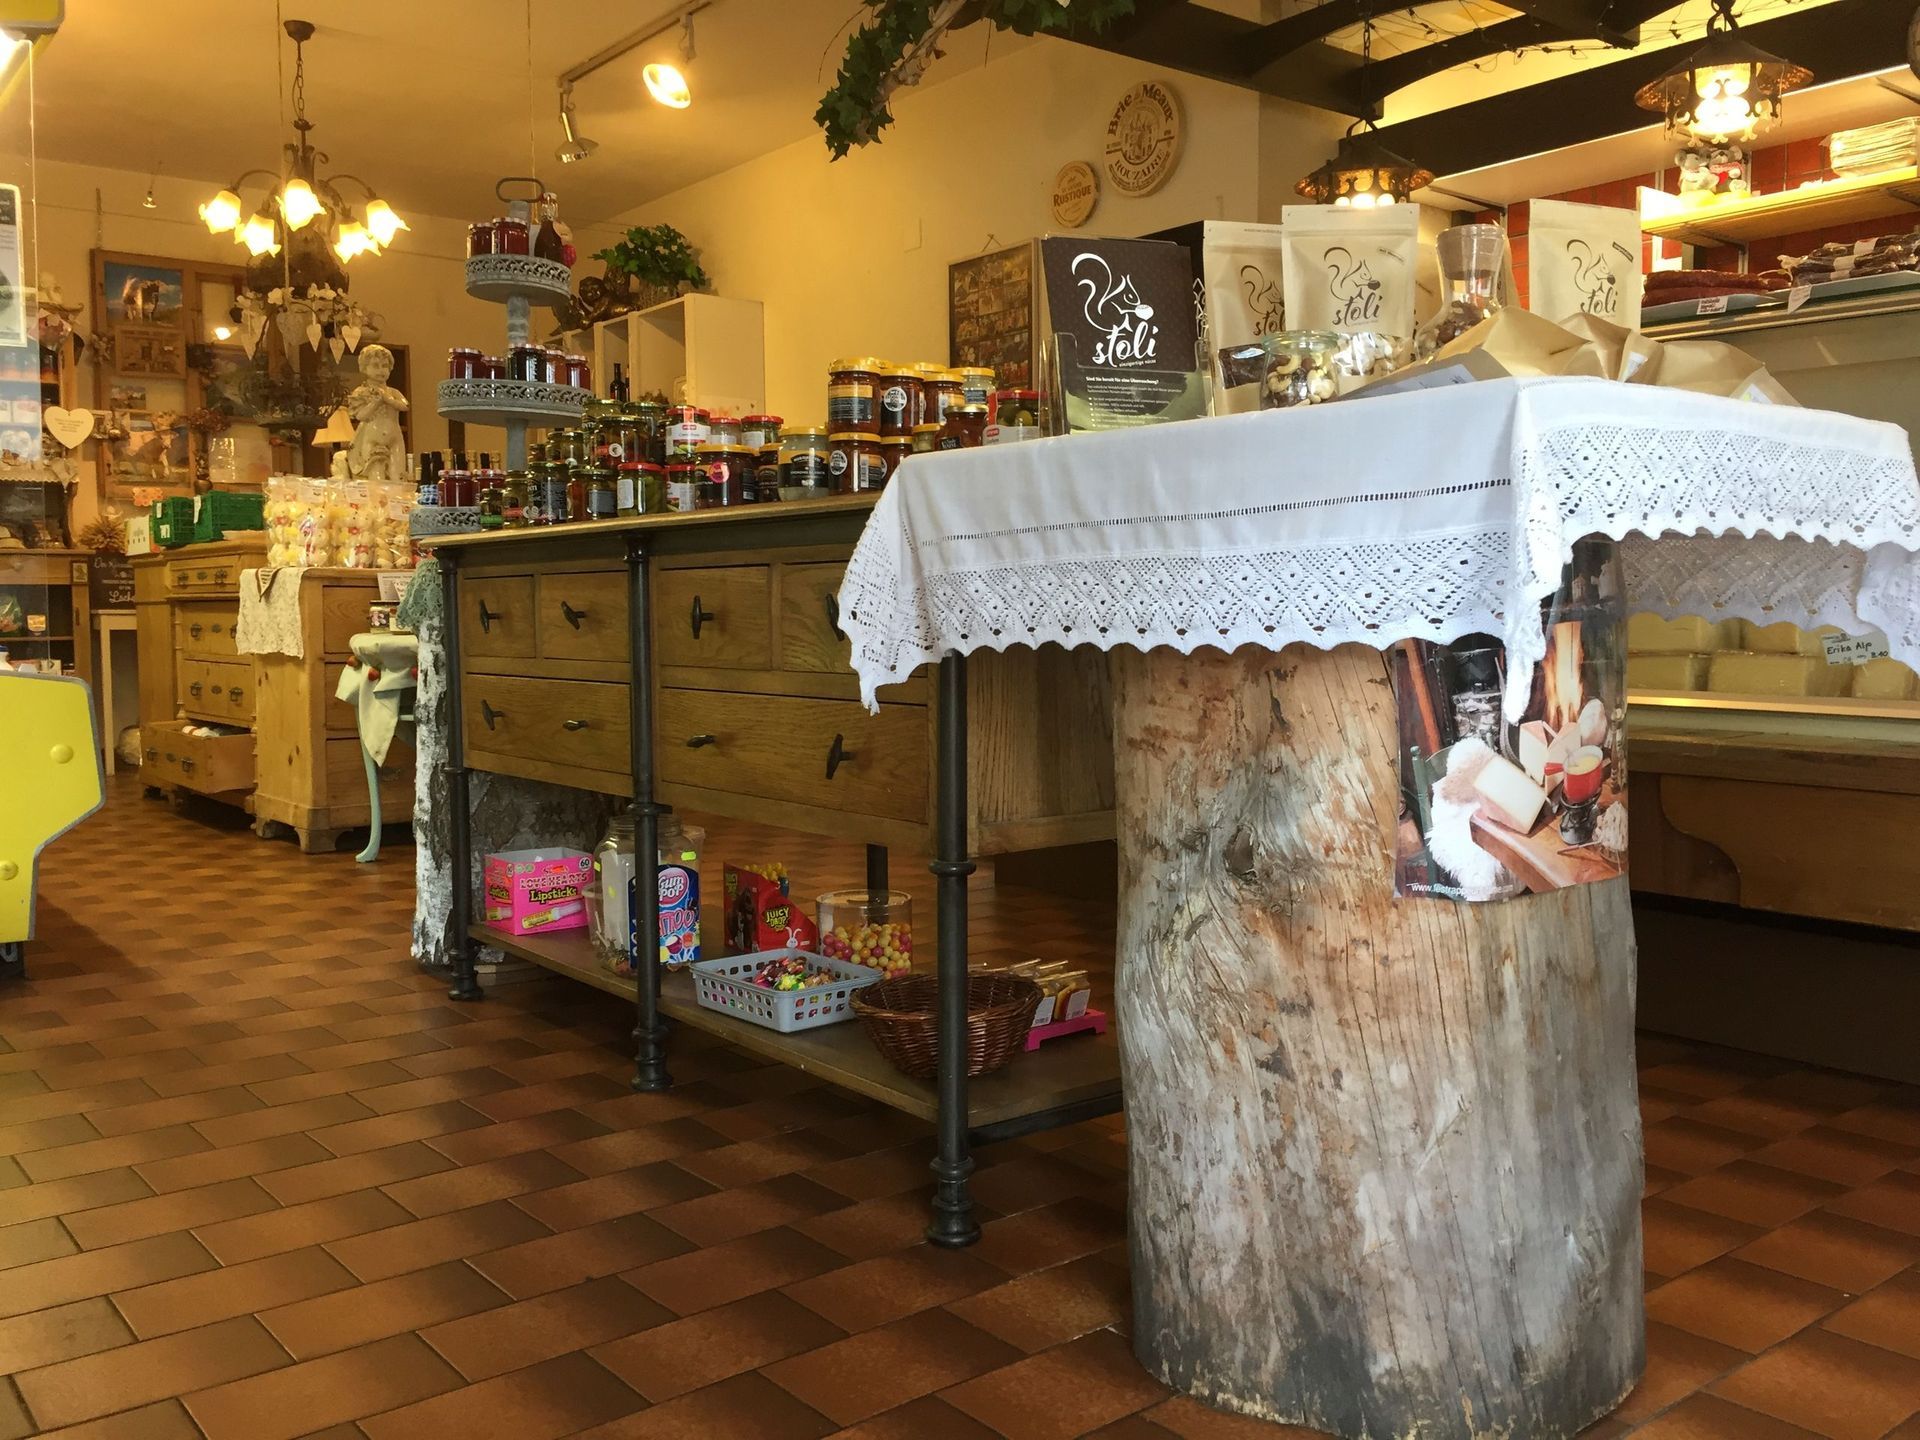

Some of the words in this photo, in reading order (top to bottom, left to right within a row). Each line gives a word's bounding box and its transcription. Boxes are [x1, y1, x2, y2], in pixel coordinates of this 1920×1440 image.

[1108, 94, 1133, 136] Brie
[1142, 84, 1174, 123] Meaux
[1332, 292, 1383, 327] stoli
[1092, 321, 1159, 368] stoli
[1827, 645, 1852, 655] Erika
[1856, 642, 1872, 652] Alp
[1580, 859, 1590, 867] 60
[529, 885, 578, 904] Lipsticks
[766, 906, 790, 923] JUICY
